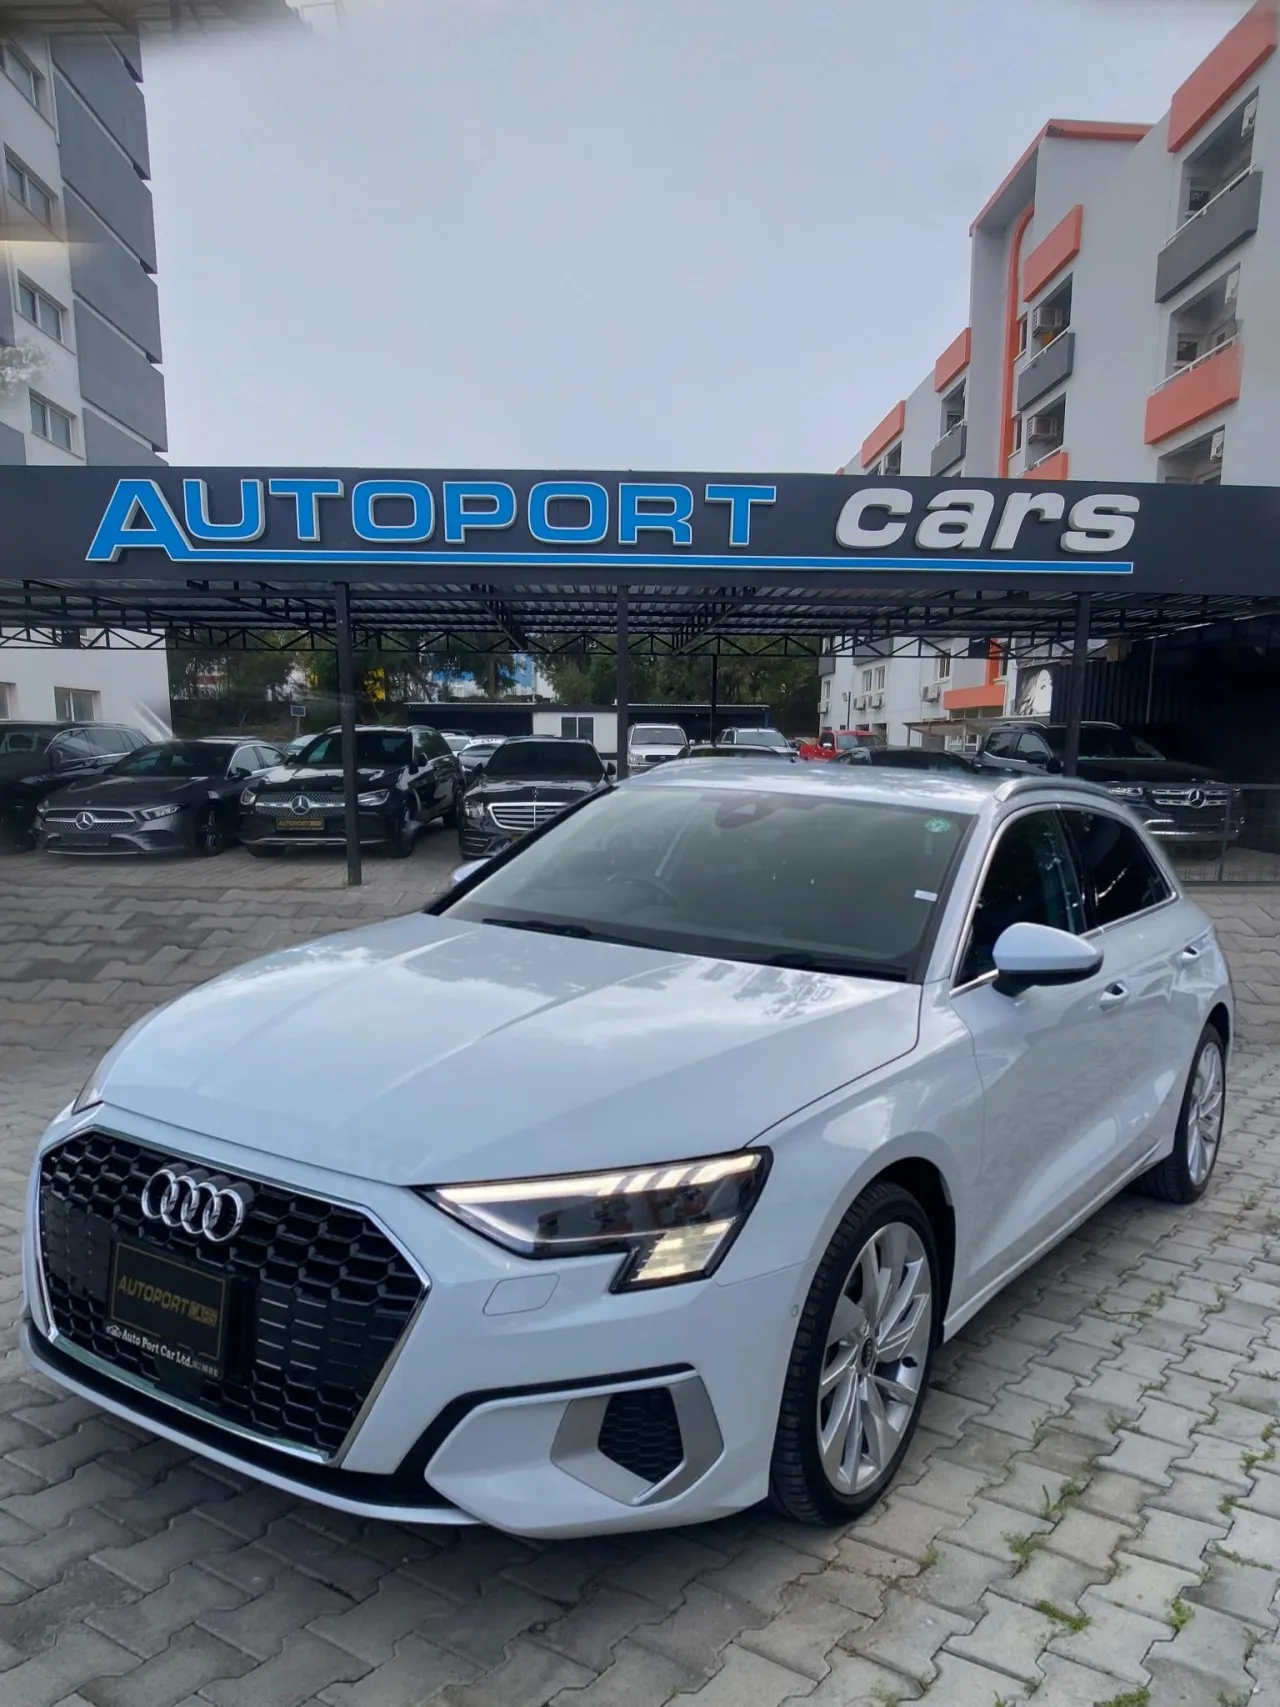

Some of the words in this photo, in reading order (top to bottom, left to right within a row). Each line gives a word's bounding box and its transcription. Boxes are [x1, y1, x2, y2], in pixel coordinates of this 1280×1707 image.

[85, 477, 778, 564] AUTOPORT
[835, 487, 1140, 554] cars
[117, 1275, 188, 1314] AUTOPORT
[122, 1329, 141, 1346] Auto
[142, 1337, 160, 1354] Port
[160, 1345, 176, 1360] Car
